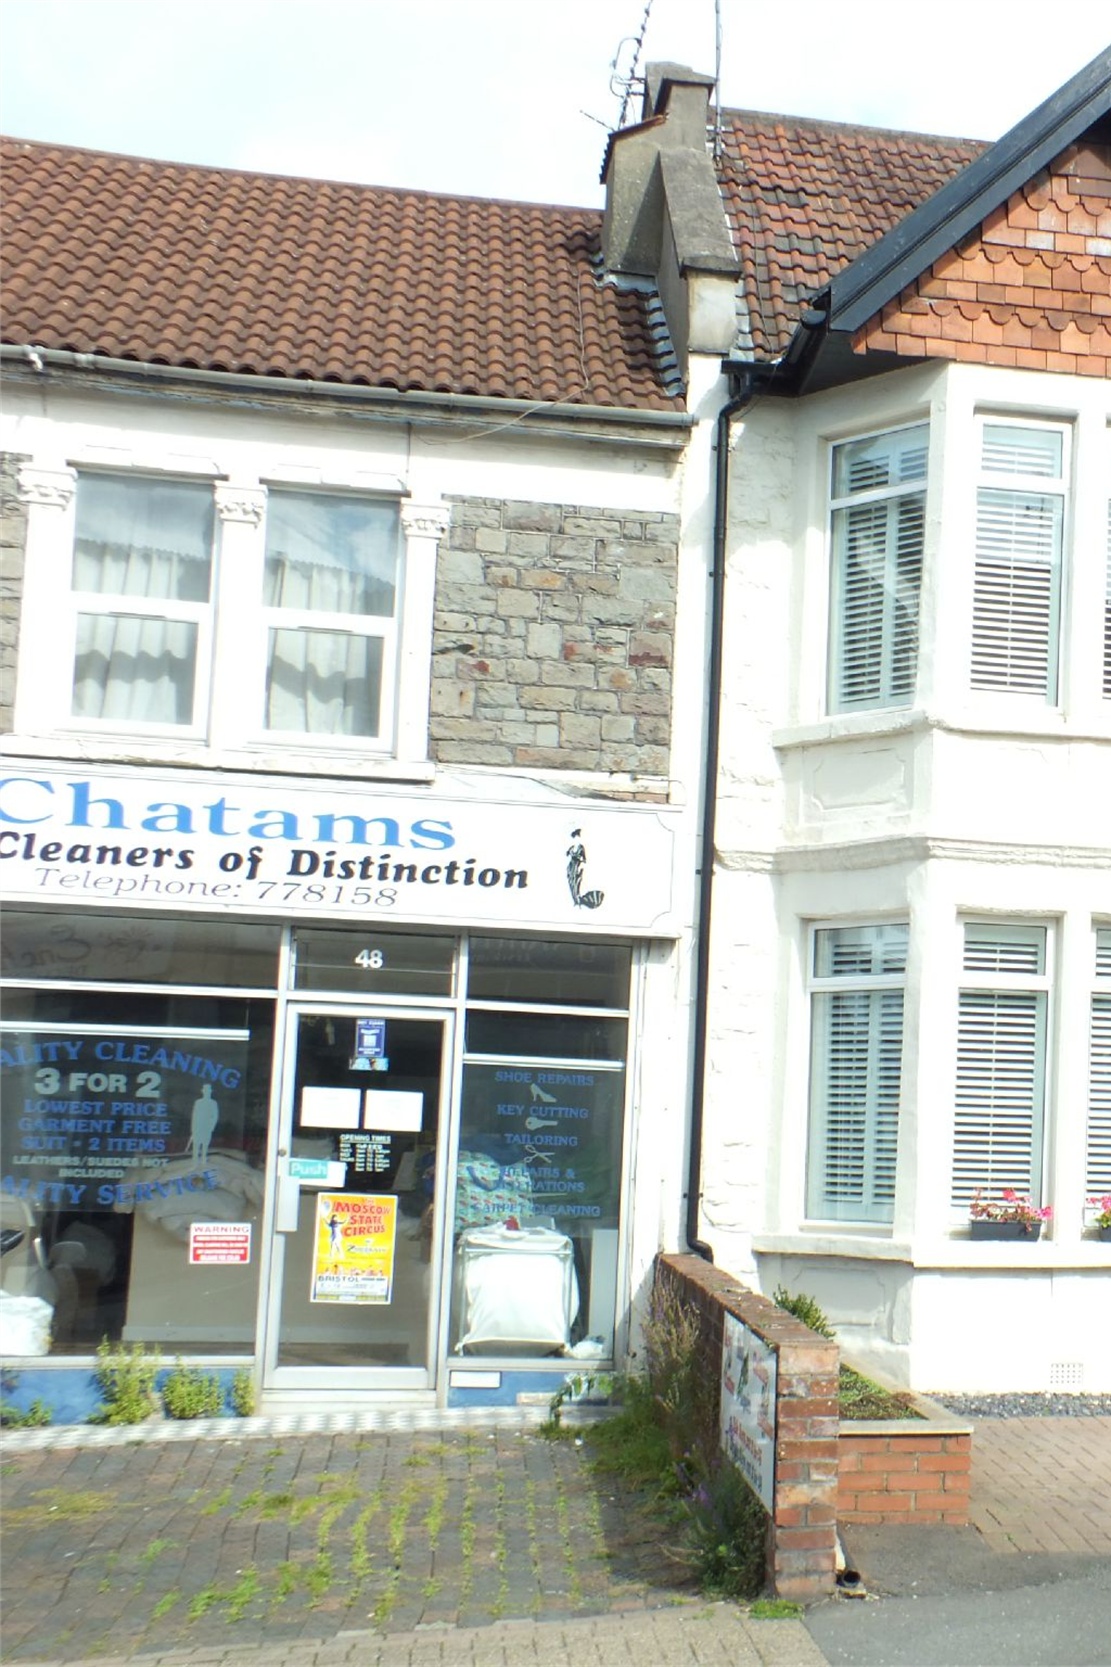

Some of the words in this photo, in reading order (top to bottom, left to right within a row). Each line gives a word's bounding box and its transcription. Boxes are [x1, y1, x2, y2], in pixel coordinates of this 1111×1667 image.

[0, 777, 456, 850] Chatams
[0, 831, 195, 870] Cleaners
[219, 846, 264, 880] of
[286, 849, 529, 889] Distinction
[35, 867, 241, 897] Telephone:
[257, 881, 399, 907] 778158
[355, 949, 384, 969] 48
[95, 1041, 242, 1089] CLEANING
[34, 1067, 60, 1095] 3
[69, 1072, 128, 1093] FOR
[135, 1071, 162, 1098] 2
[495, 1071, 533, 1083] SHOE
[537, 1073, 594, 1086] REPAIRS
[24, 1099, 105, 1115] LOWEST
[111, 1102, 168, 1117] PRICE
[497, 1104, 525, 1115] KEY
[529, 1106, 589, 1119] CUTTING
[18, 1117, 116, 1133] GARMENT
[122, 1121, 172, 1134] FREE
[21, 1136, 67, 1149] SUIT
[88, 1137, 100, 1151] 2
[107, 1138, 166, 1152] ITEMS
[504, 1133, 578, 1146] TAILORING
[142, 1158, 170, 1168] NOT
[291, 1162, 327, 1175] Push
[59, 1168, 125, 1178] INCLUDED
[503, 1166, 560, 1179] PAIRS
[96, 1169, 218, 1205] SERVICE
[333, 1202, 391, 1214] MOSCOW
[532, 1203, 601, 1217] CLEANING
[350, 1215, 382, 1225] STATE
[343, 1225, 386, 1237] CIRCUS
